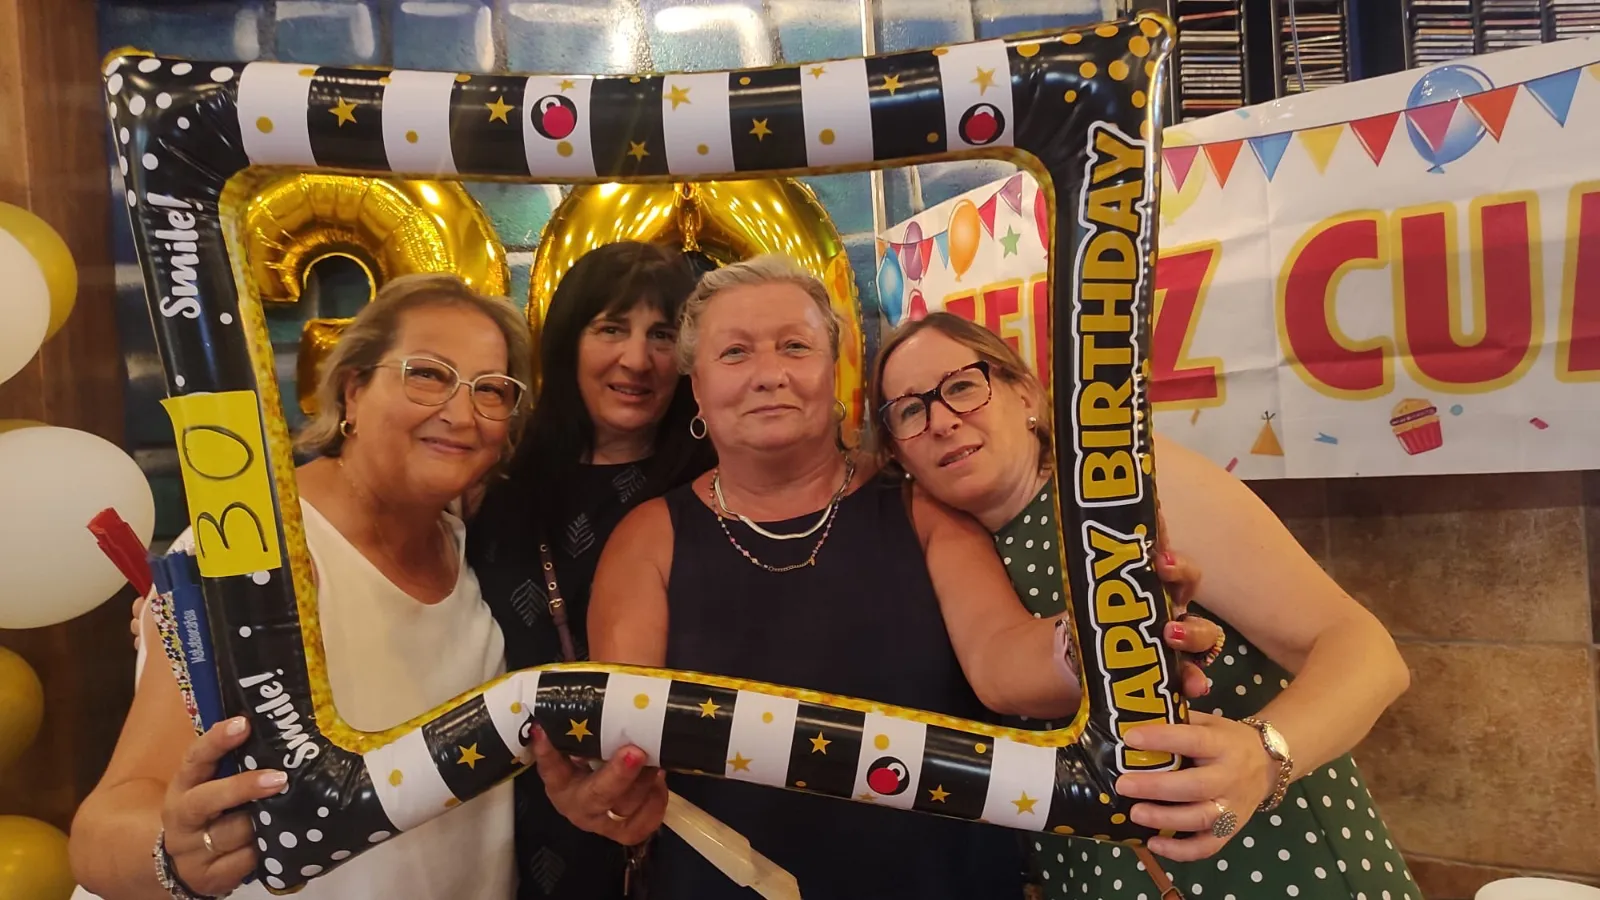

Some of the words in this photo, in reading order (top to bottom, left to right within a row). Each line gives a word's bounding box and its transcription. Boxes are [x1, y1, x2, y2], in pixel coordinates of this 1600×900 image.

[146, 192, 204, 319] Smile!
[1073, 121, 1150, 507] BIRTHDAY
[1275, 180, 1600, 400] CU
[182, 425, 269, 558] 30
[239, 668, 320, 769] Smile!
[1082, 520, 1182, 773] HAPPY
